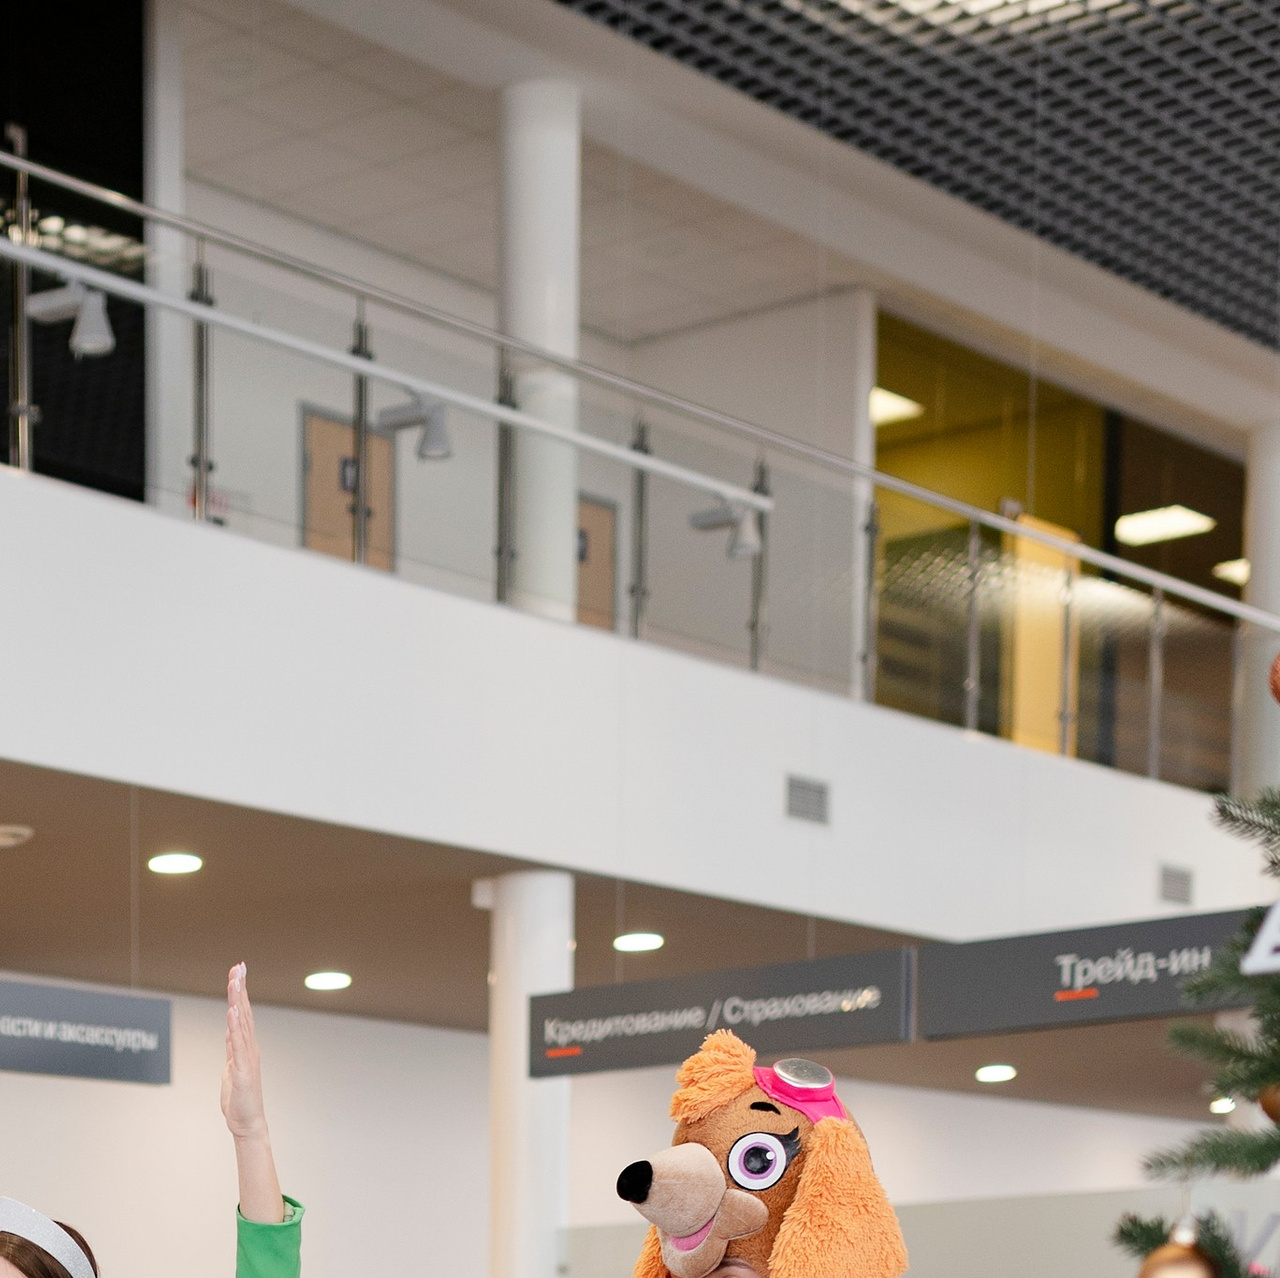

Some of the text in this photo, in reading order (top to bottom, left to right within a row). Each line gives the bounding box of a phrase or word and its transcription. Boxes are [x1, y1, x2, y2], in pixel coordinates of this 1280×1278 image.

[1055, 946, 1210, 990] Трейд-ин
[43, 1020, 58, 1040] и
[545, 1006, 707, 1046] Кредитование
[724, 986, 881, 1026] Страхование
